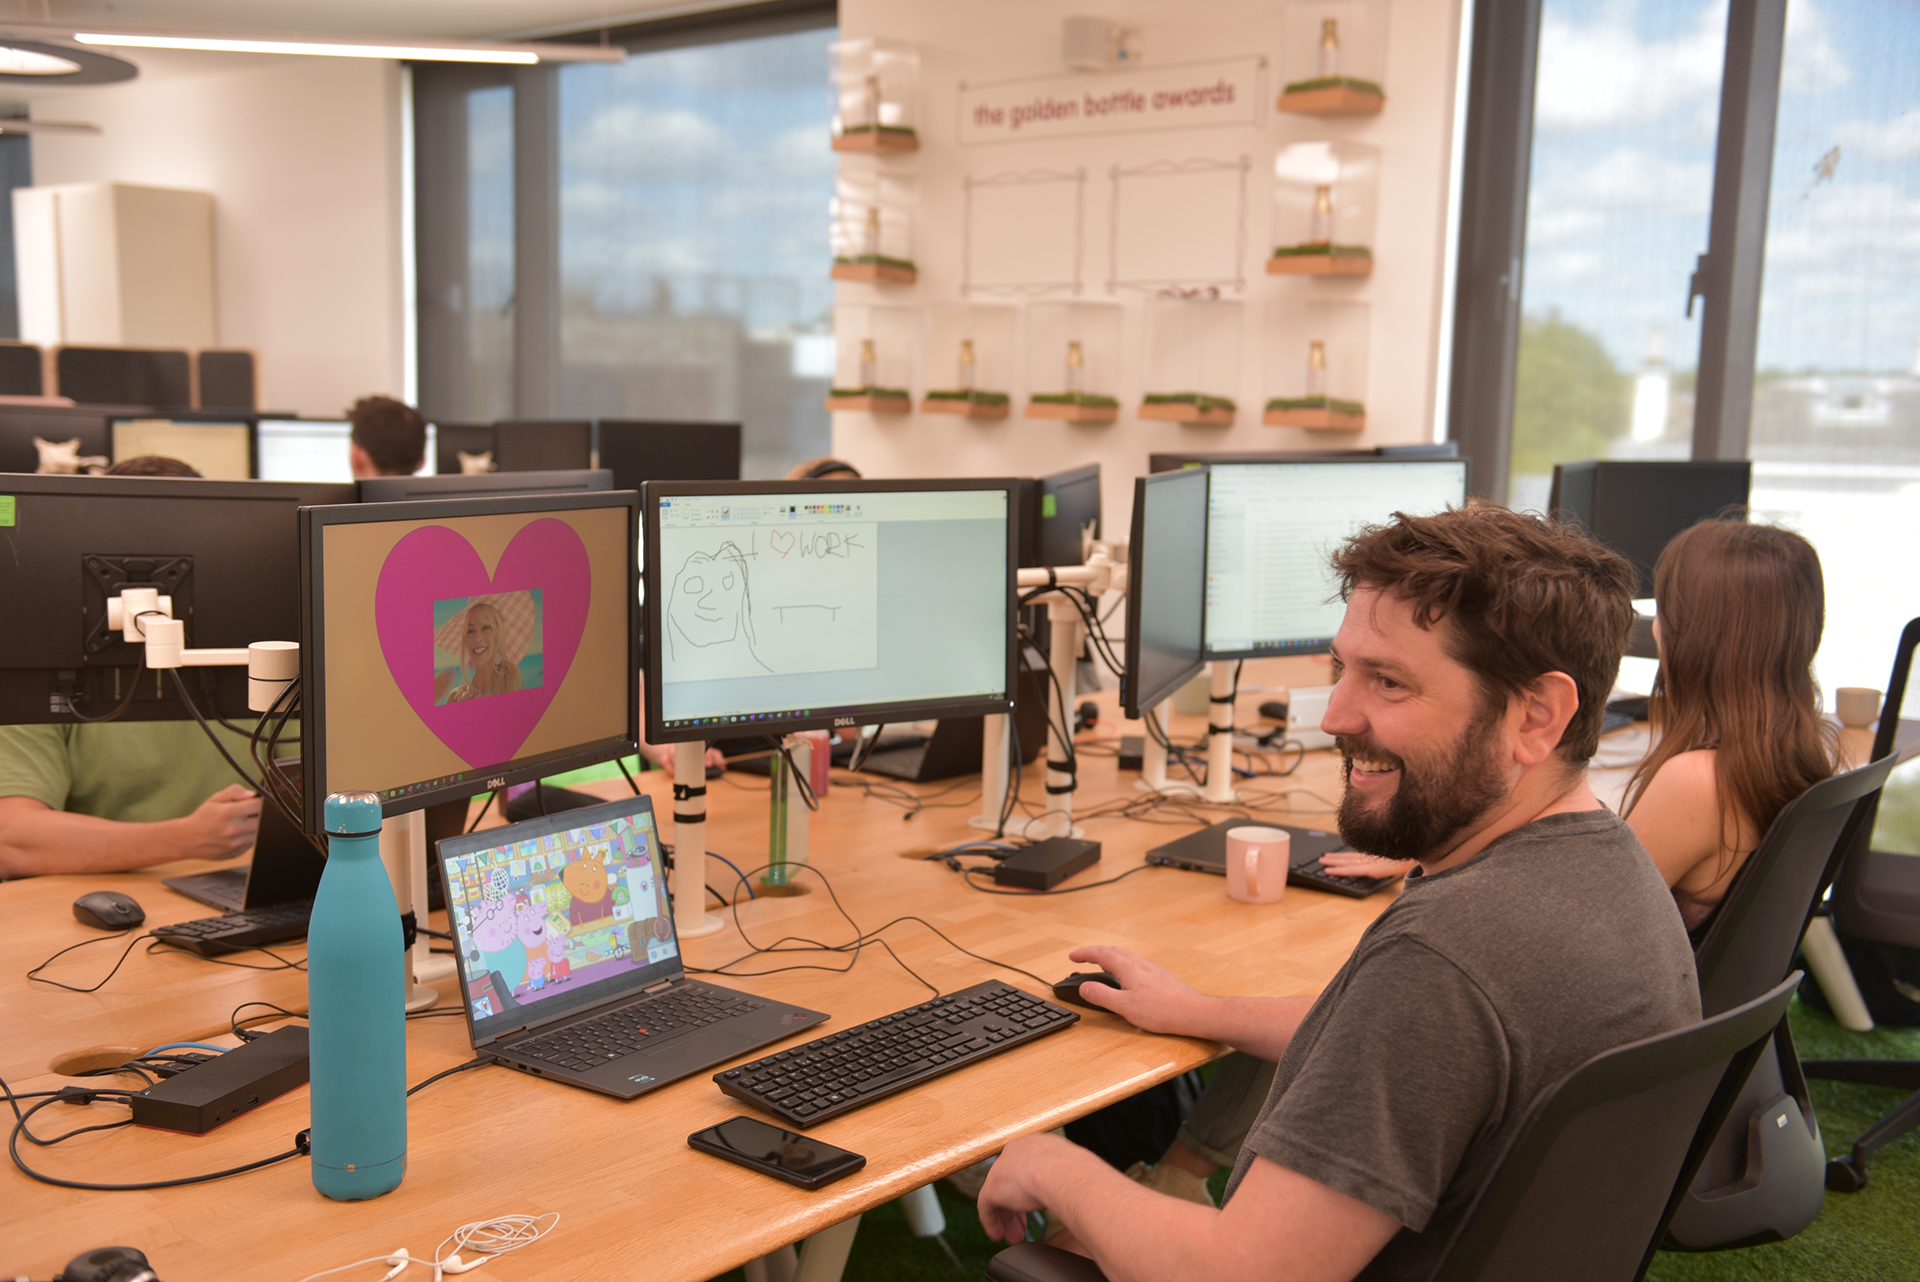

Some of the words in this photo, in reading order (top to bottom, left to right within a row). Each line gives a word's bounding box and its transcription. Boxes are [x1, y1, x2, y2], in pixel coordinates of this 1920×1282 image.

[973, 104, 1004, 127] the
[1009, 96, 1079, 130] golden
[1083, 88, 1146, 117] bottle
[1151, 78, 1236, 111] awards
[800, 530, 865, 559] WORK
[833, 716, 856, 727] DELL
[486, 776, 506, 790] DELL
